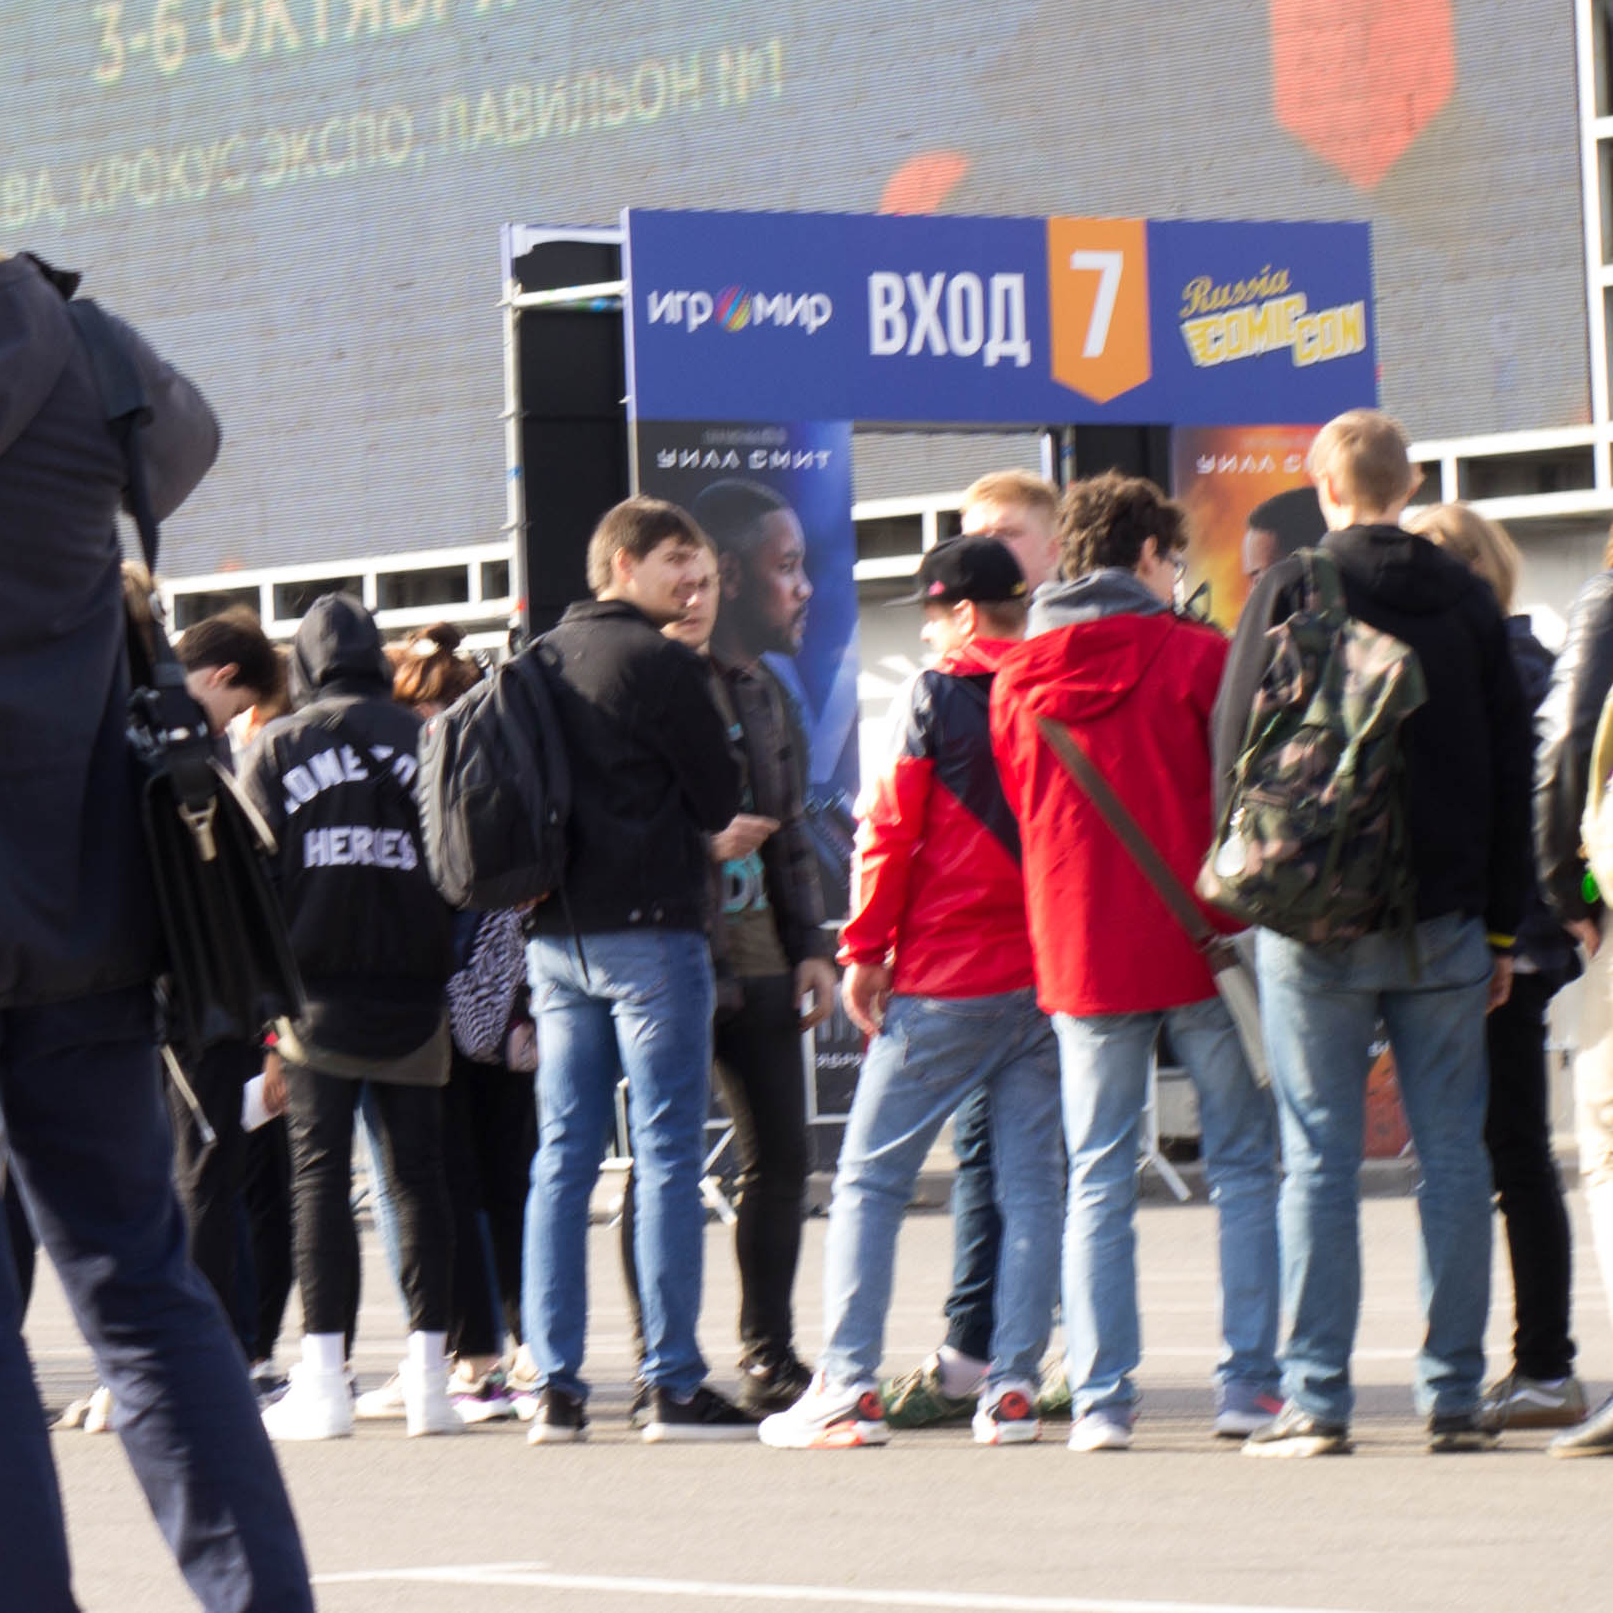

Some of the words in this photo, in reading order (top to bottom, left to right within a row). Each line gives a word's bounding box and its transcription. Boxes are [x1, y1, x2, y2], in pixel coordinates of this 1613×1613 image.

[80, 135, 249, 213] КРОКУС
[440, 51, 703, 150] ПАВИЛЬОН
[867, 271, 1032, 368] ВХОД
[1069, 250, 1124, 359] 7
[1178, 263, 1292, 318] Russia
[1180, 291, 1308, 368] COMIC
[1291, 299, 1367, 368] CON
[656, 447, 741, 470] УИЛЛ
[747, 447, 833, 470] СМИТ
[1195, 453, 1277, 475] УИЛЛ
